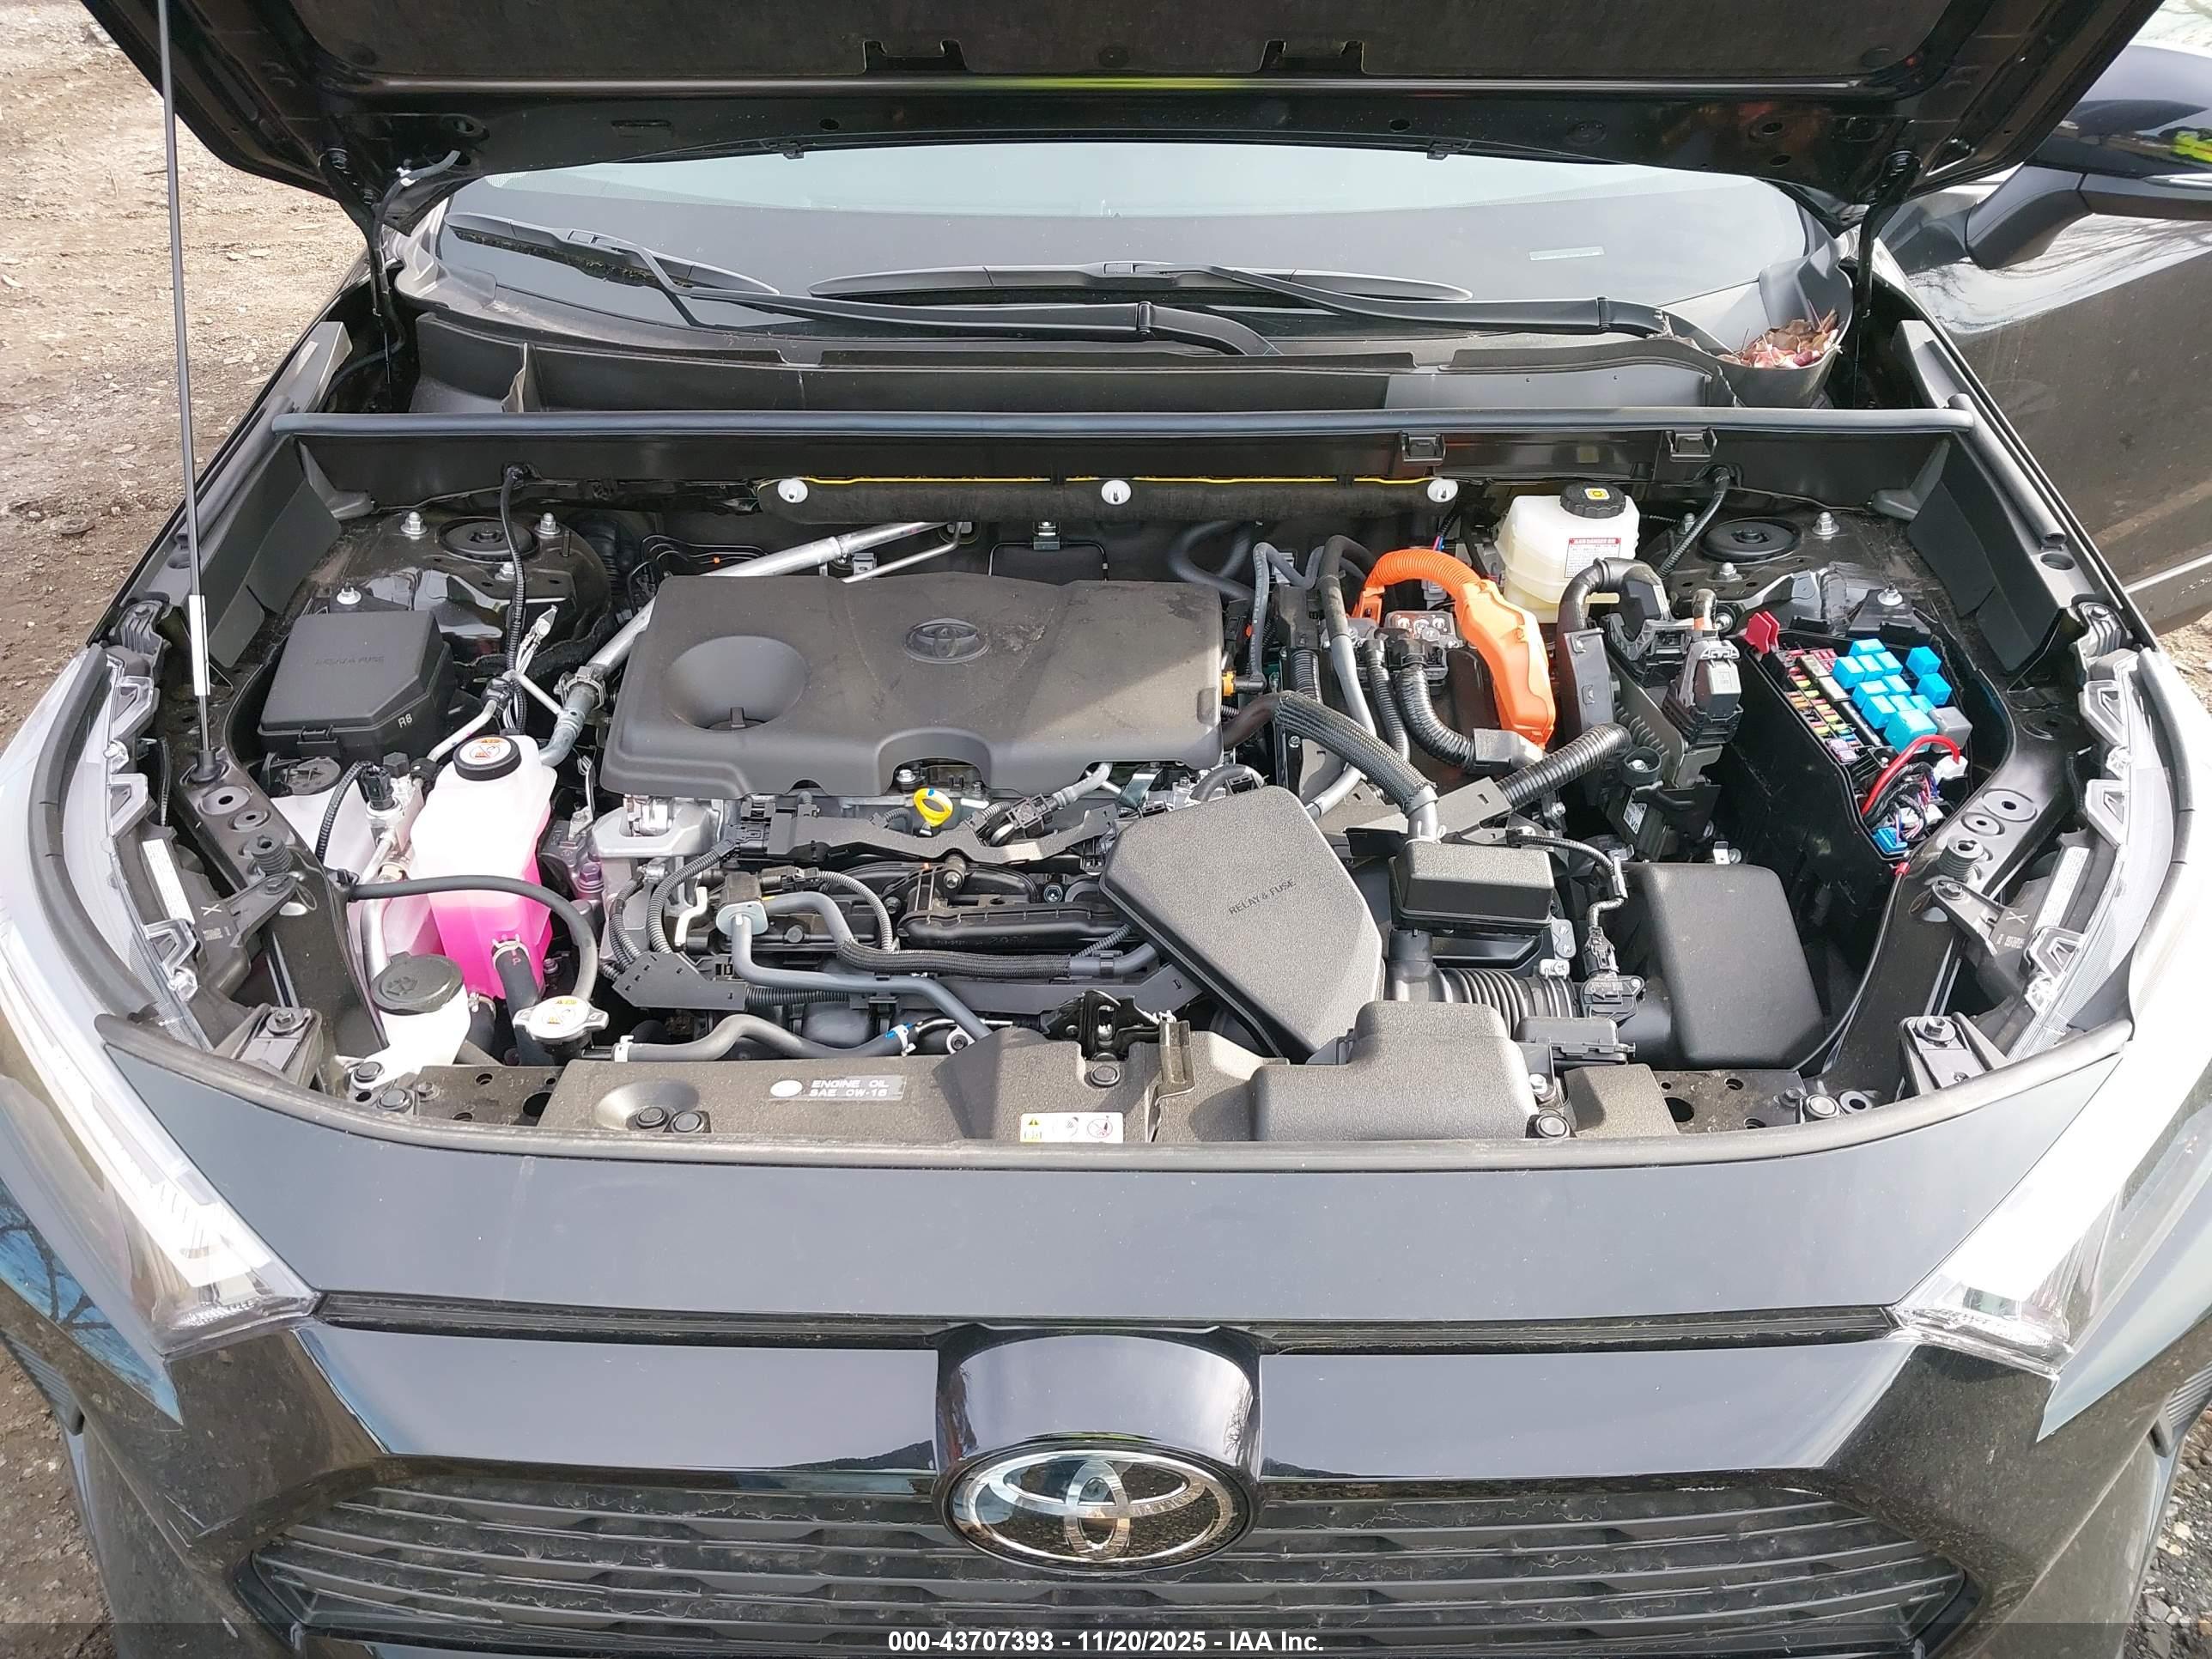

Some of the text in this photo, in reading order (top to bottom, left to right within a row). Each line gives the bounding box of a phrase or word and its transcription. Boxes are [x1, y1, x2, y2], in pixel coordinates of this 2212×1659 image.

[398, 714, 413, 728] R8
[1228, 895, 1261, 915] RELAY
[1269, 878, 1297, 896] FUSE
[811, 1079, 890, 1088] ENGINE OIL
[809, 1089, 838, 1097] SAE
